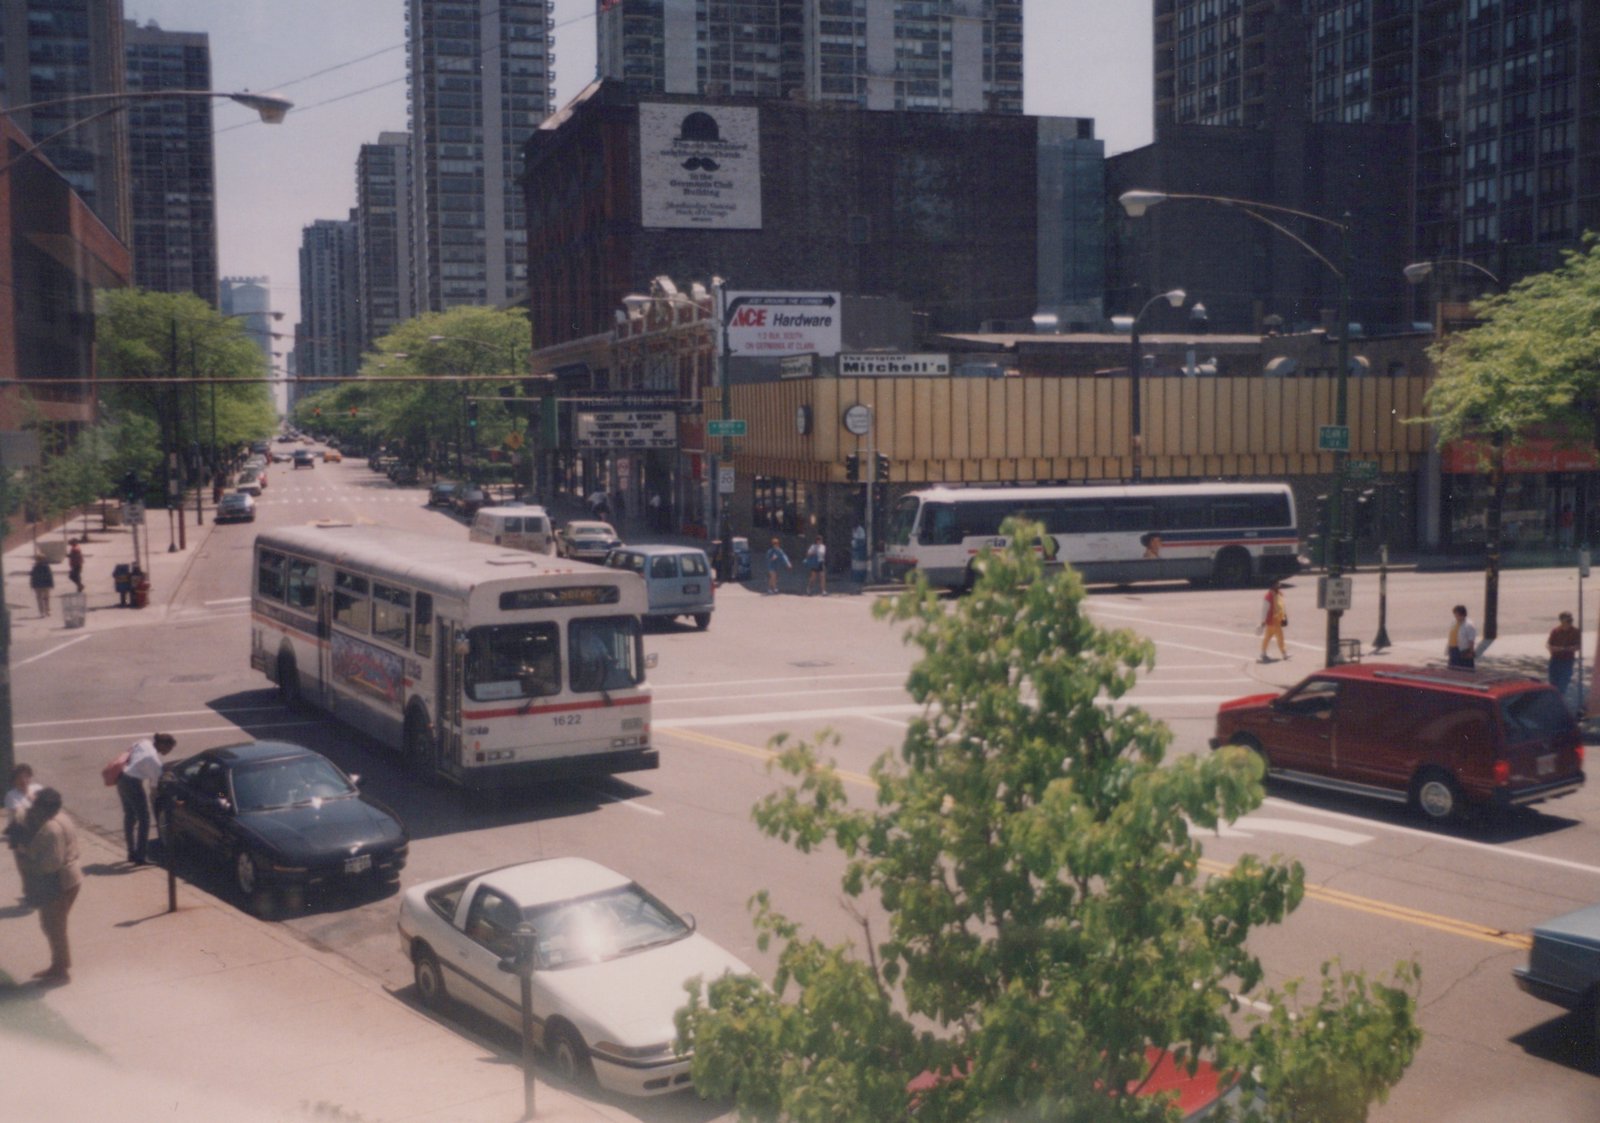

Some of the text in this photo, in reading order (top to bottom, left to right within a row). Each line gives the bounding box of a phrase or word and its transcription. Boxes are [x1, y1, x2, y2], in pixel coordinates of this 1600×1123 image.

[732, 308, 833, 328] ACE Hardware
[843, 362, 947, 374] Mitchell's
[552, 715, 582, 726] 1622
